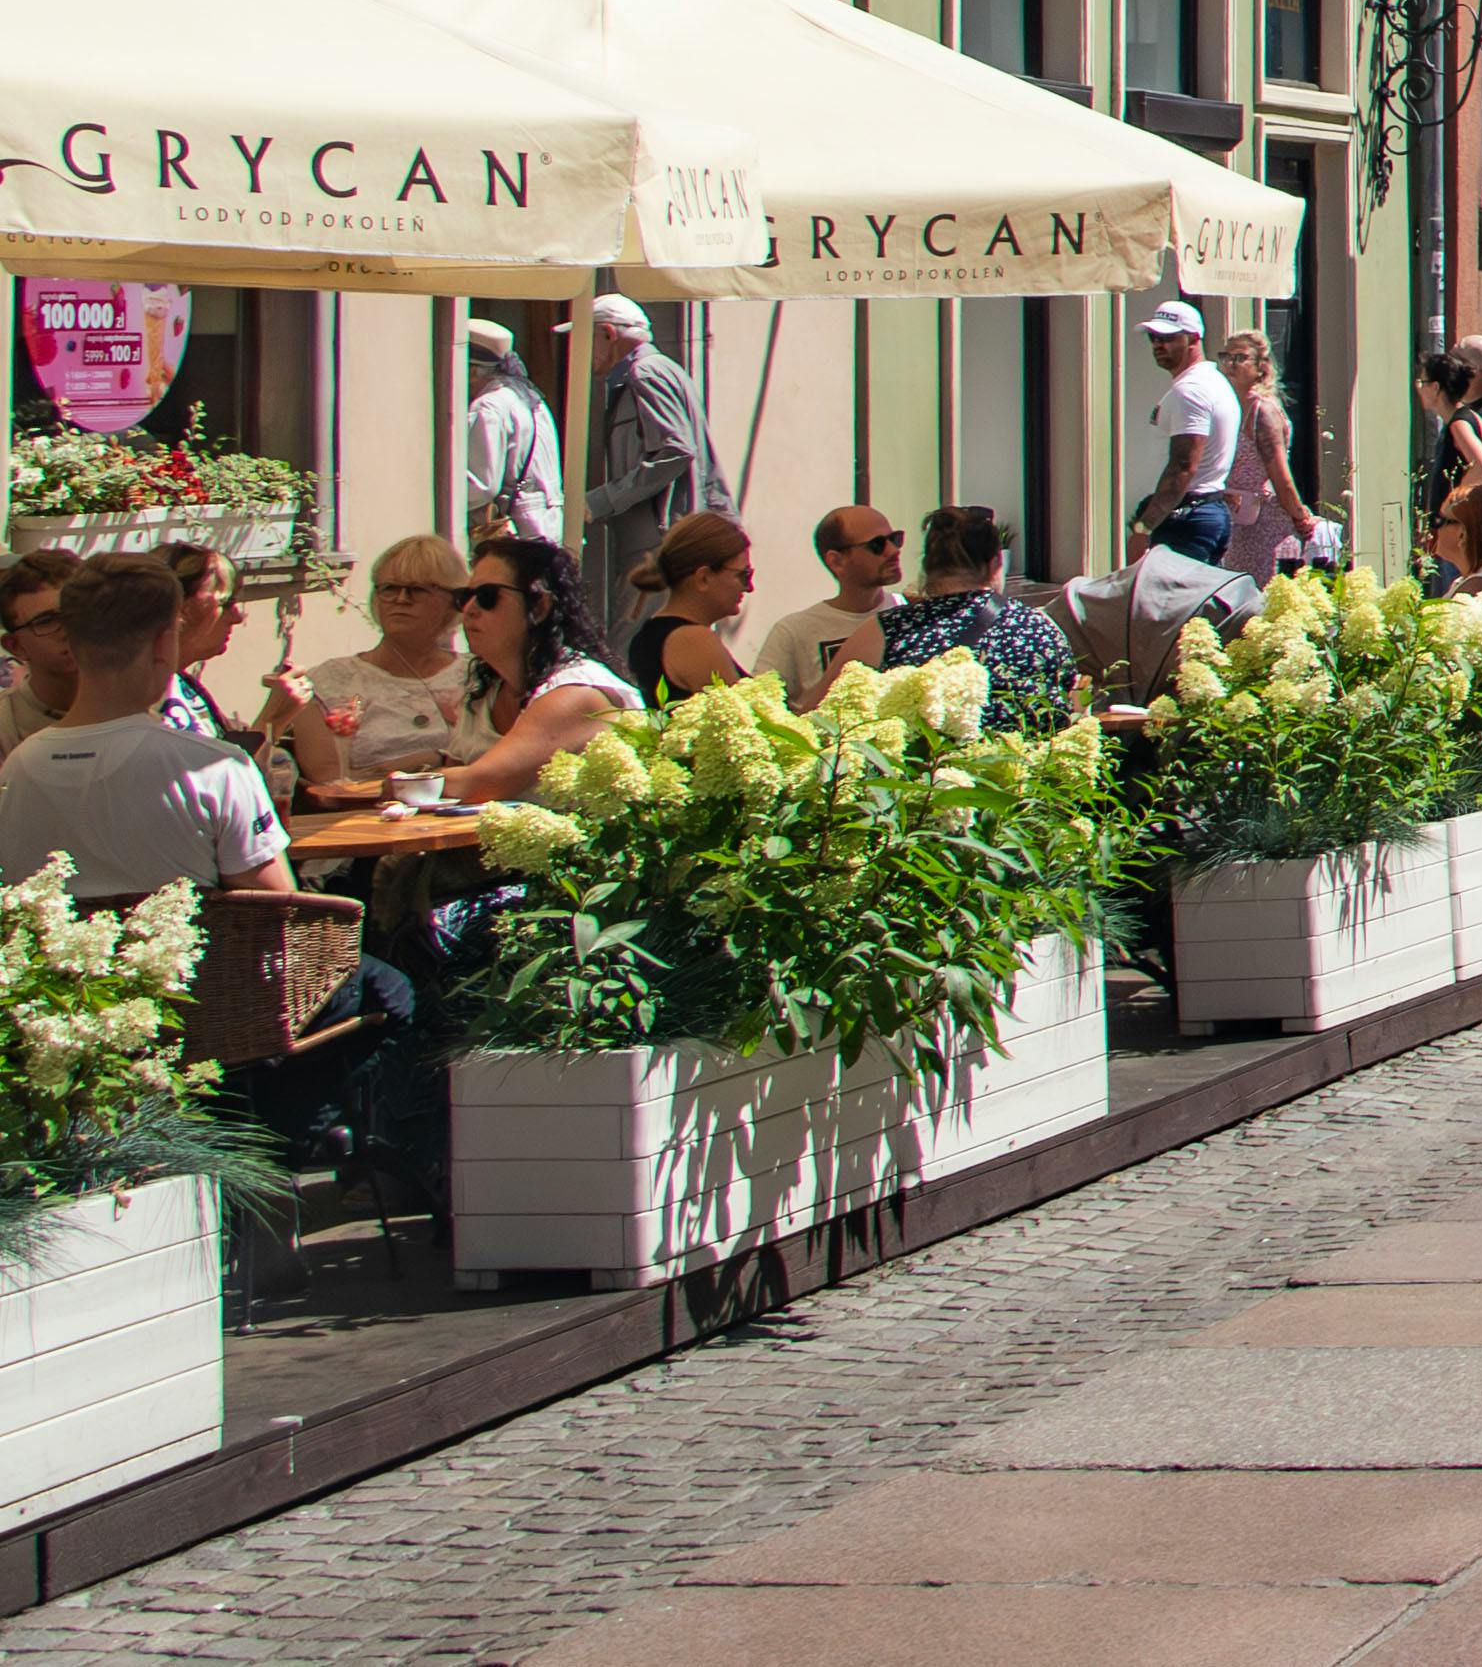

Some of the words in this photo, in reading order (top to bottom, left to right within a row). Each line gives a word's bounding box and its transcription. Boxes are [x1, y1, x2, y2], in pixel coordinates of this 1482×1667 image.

[61, 122, 529, 208] GRYCAN
[179, 206, 247, 224] LODY
[259, 211, 292, 226] OD
[305, 213, 425, 232] POKOLEŃ
[1197, 218, 1283, 264] GRYCAN
[825, 270, 875, 282] LODY
[883, 269, 908, 281] OD
[917, 266, 1005, 281] POKOLEŃ
[41, 302, 75, 329] 100
[78, 302, 114, 329] 000
[110, 344, 131, 362] 100
